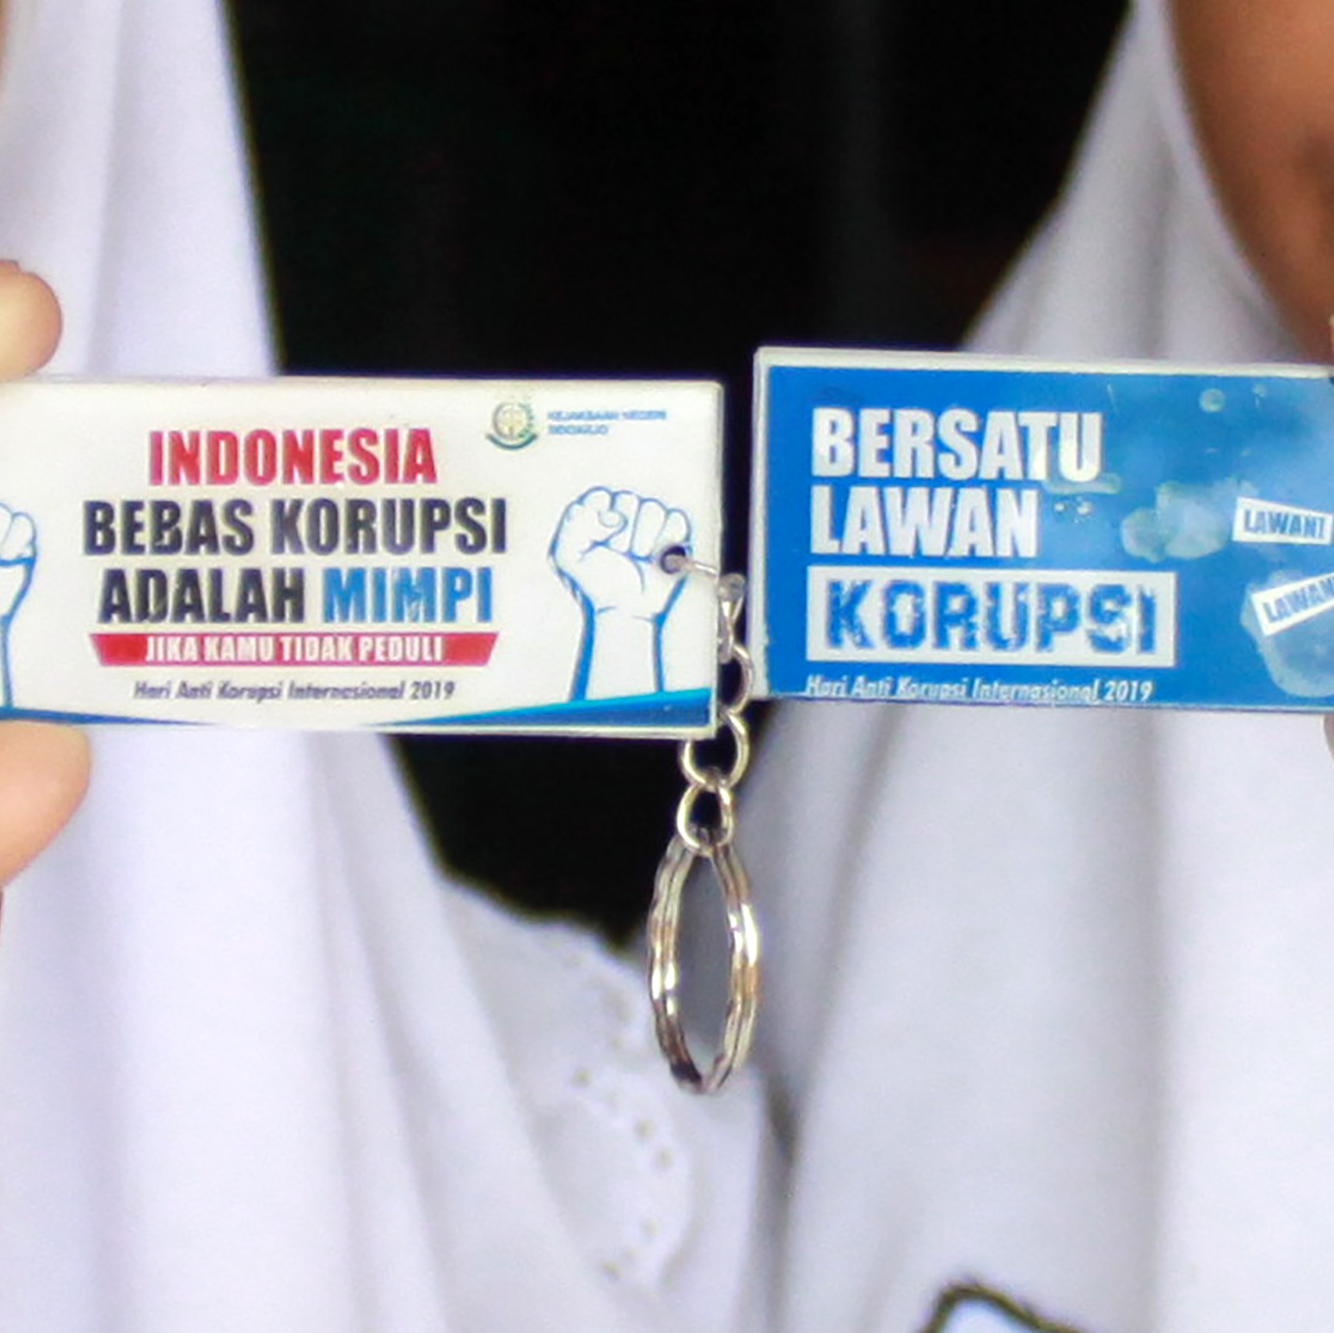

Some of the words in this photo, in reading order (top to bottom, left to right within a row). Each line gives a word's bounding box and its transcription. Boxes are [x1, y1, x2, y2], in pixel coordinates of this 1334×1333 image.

[149, 428, 438, 486] INDONESIA
[811, 407, 1103, 482] BERSATU
[83, 499, 255, 556] BEBAS
[271, 497, 507, 555] KORUPSI
[811, 484, 1038, 558] LAWAN
[97, 567, 305, 624] ADALAH
[321, 566, 494, 624] MIMPI
[826, 579, 1158, 655] KORUPSI
[145, 635, 198, 663] JIKA
[204, 635, 273, 663] KAMU
[279, 635, 353, 662] TIDAK
[359, 635, 443, 662] PEDULI
[133, 680, 171, 700] Hari
[176, 680, 212, 700] Anti
[217, 680, 282, 704] Korupsi
[287, 680, 405, 700] Internasional
[410, 680, 456, 700] 2019
[806, 674, 847, 697] Hari
[852, 675, 891, 698] Anti
[896, 677, 968, 700] Korupsi
[972, 678, 1100, 702] Internasional
[1104, 680, 1154, 701] 2019
